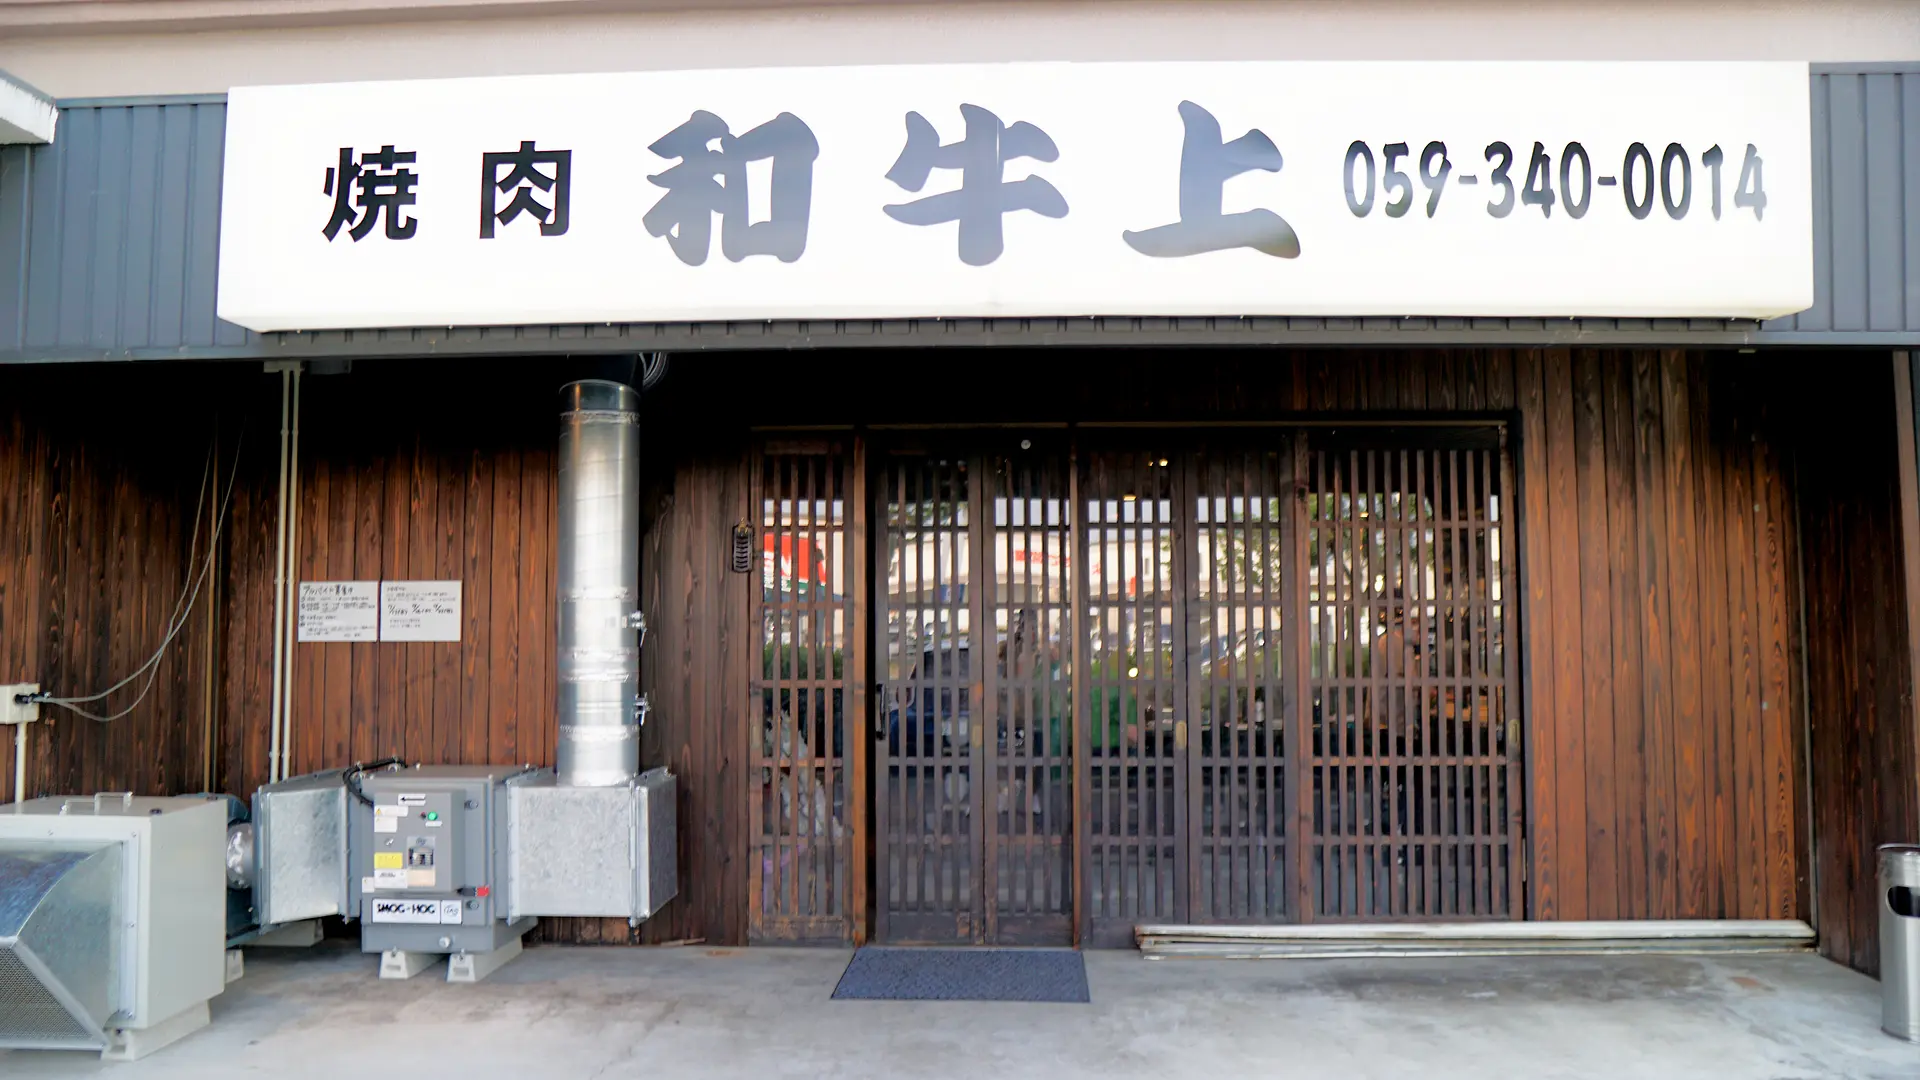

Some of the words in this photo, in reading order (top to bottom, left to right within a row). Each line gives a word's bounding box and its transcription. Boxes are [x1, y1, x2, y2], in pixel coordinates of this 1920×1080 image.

[322, 141, 572, 243] 焼肉
[642, 100, 1301, 266] 和牛上
[1344, 140, 1766, 221] 059-340-0014
